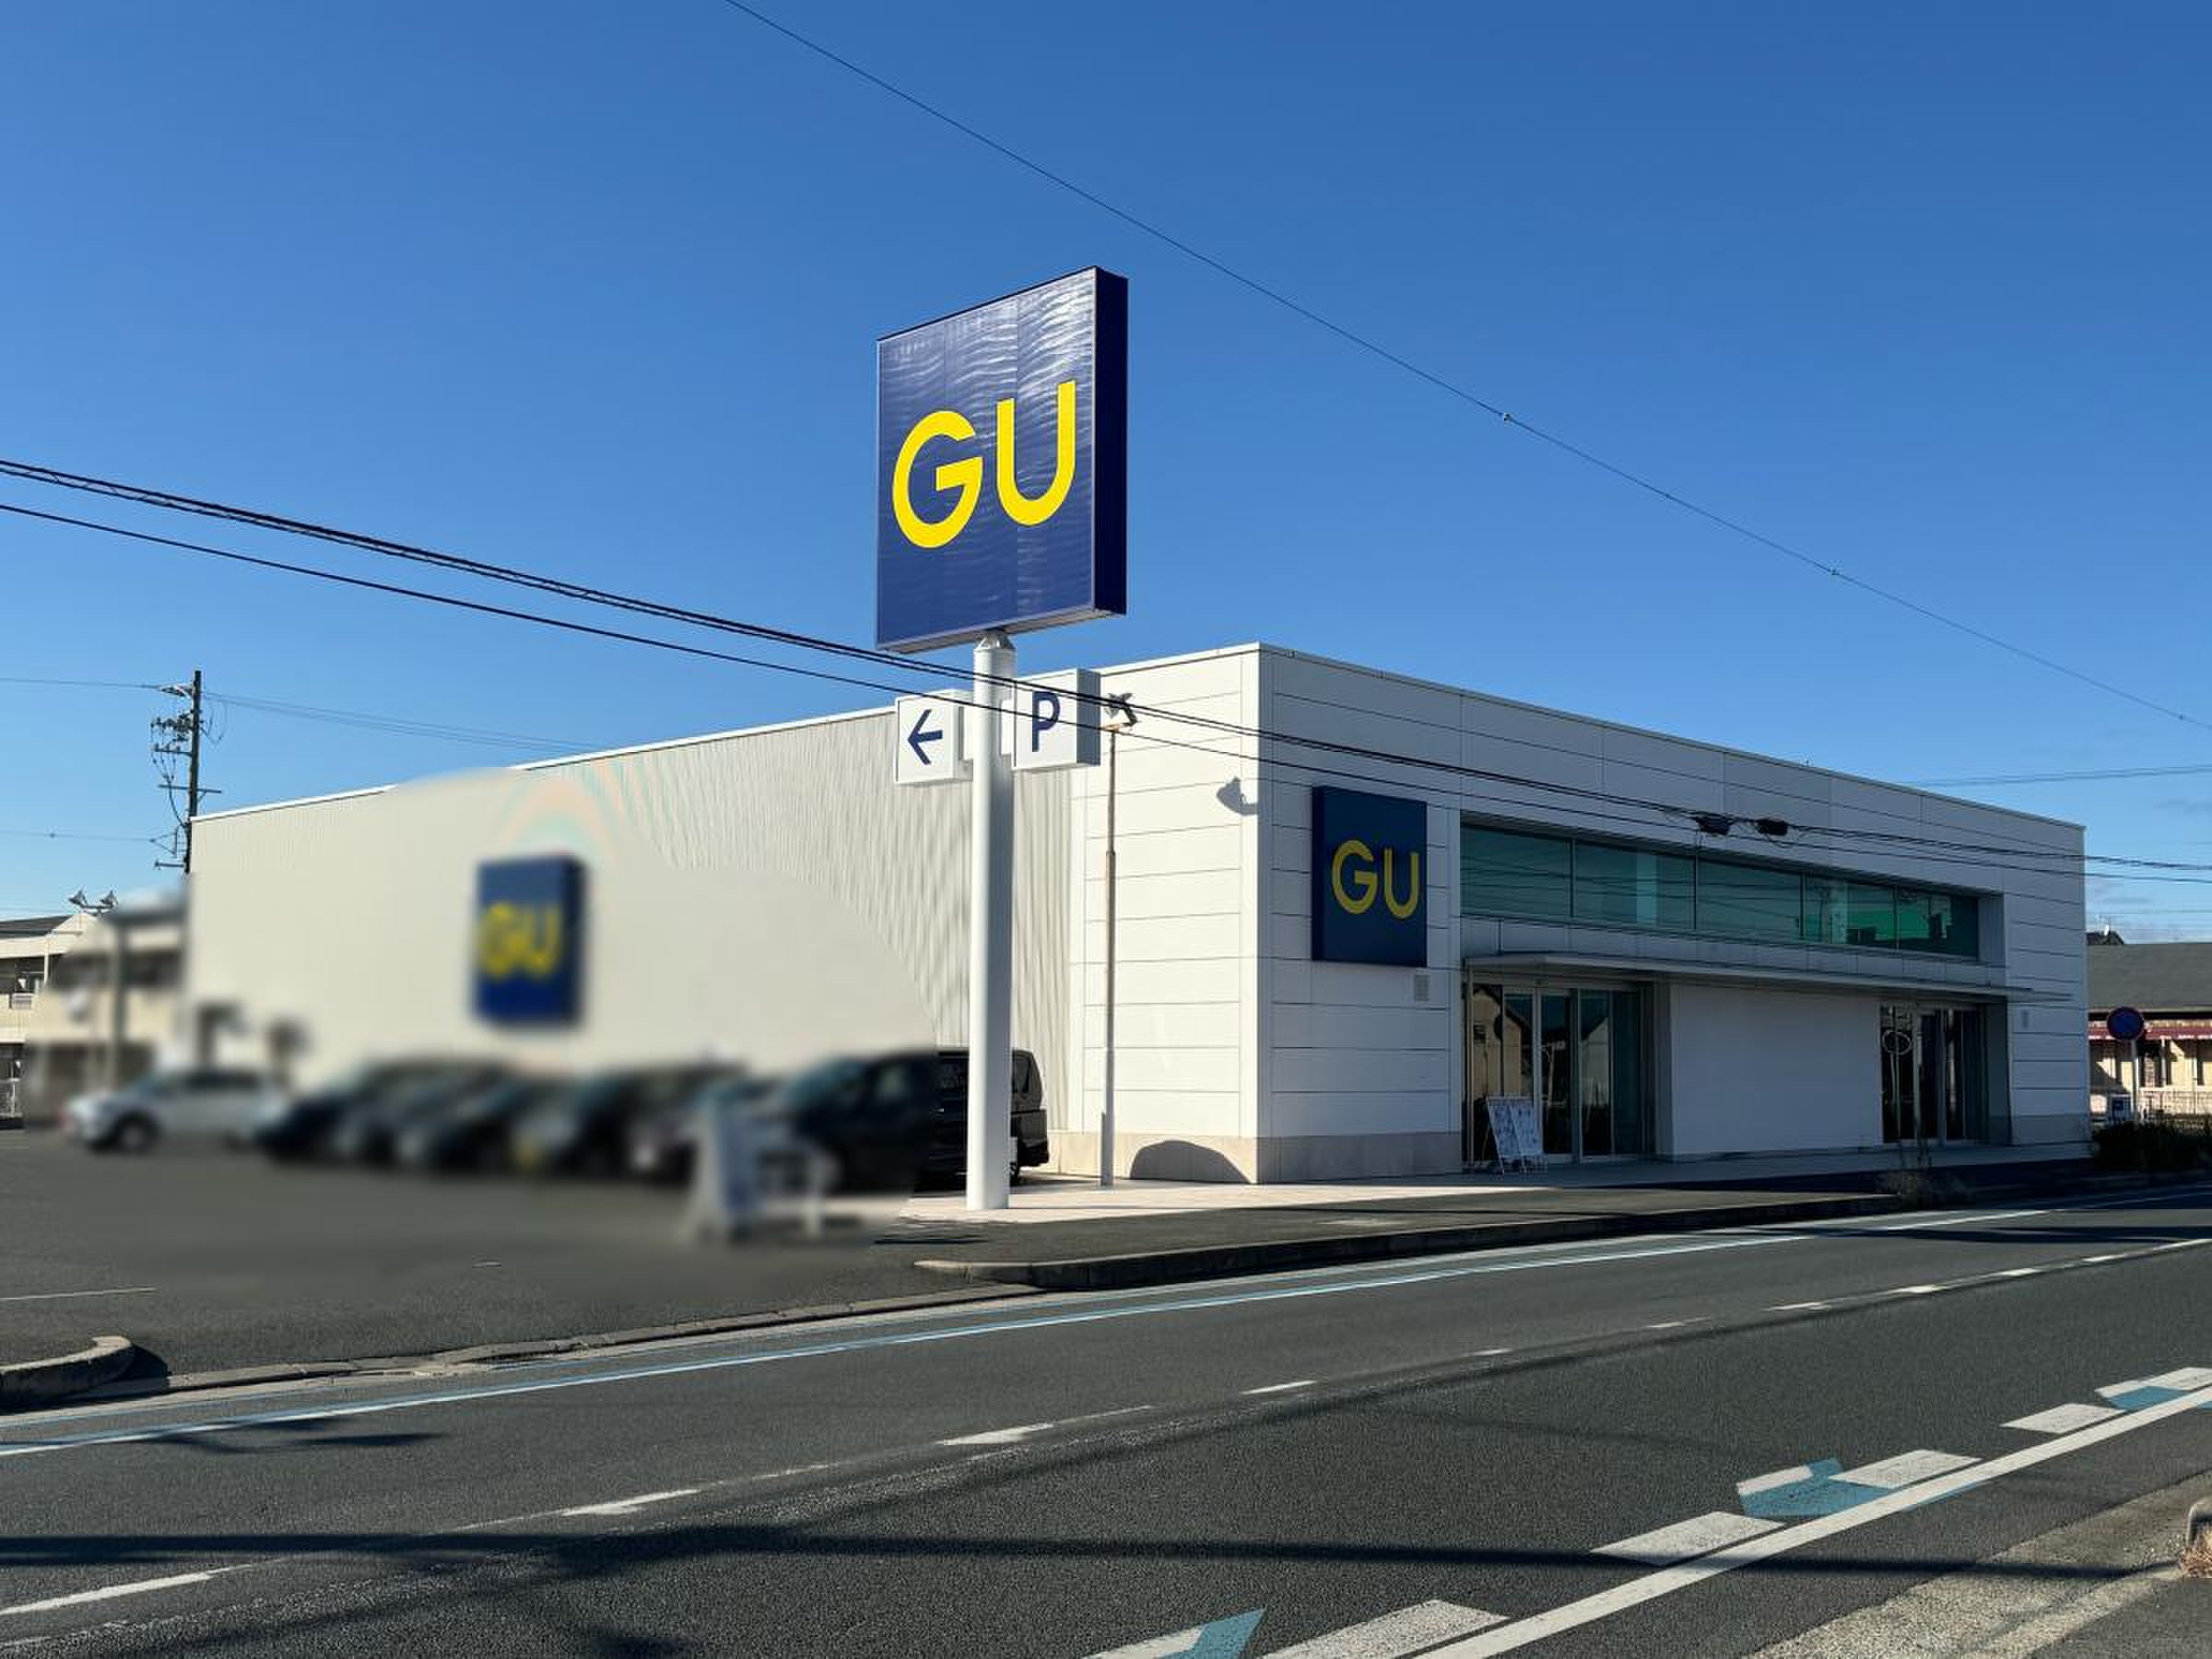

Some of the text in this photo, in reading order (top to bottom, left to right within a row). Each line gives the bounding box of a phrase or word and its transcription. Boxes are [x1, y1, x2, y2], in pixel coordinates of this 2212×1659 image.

[891, 381, 1077, 549] GU
[1031, 691, 1060, 753] P
[1332, 840, 1419, 919] GU
